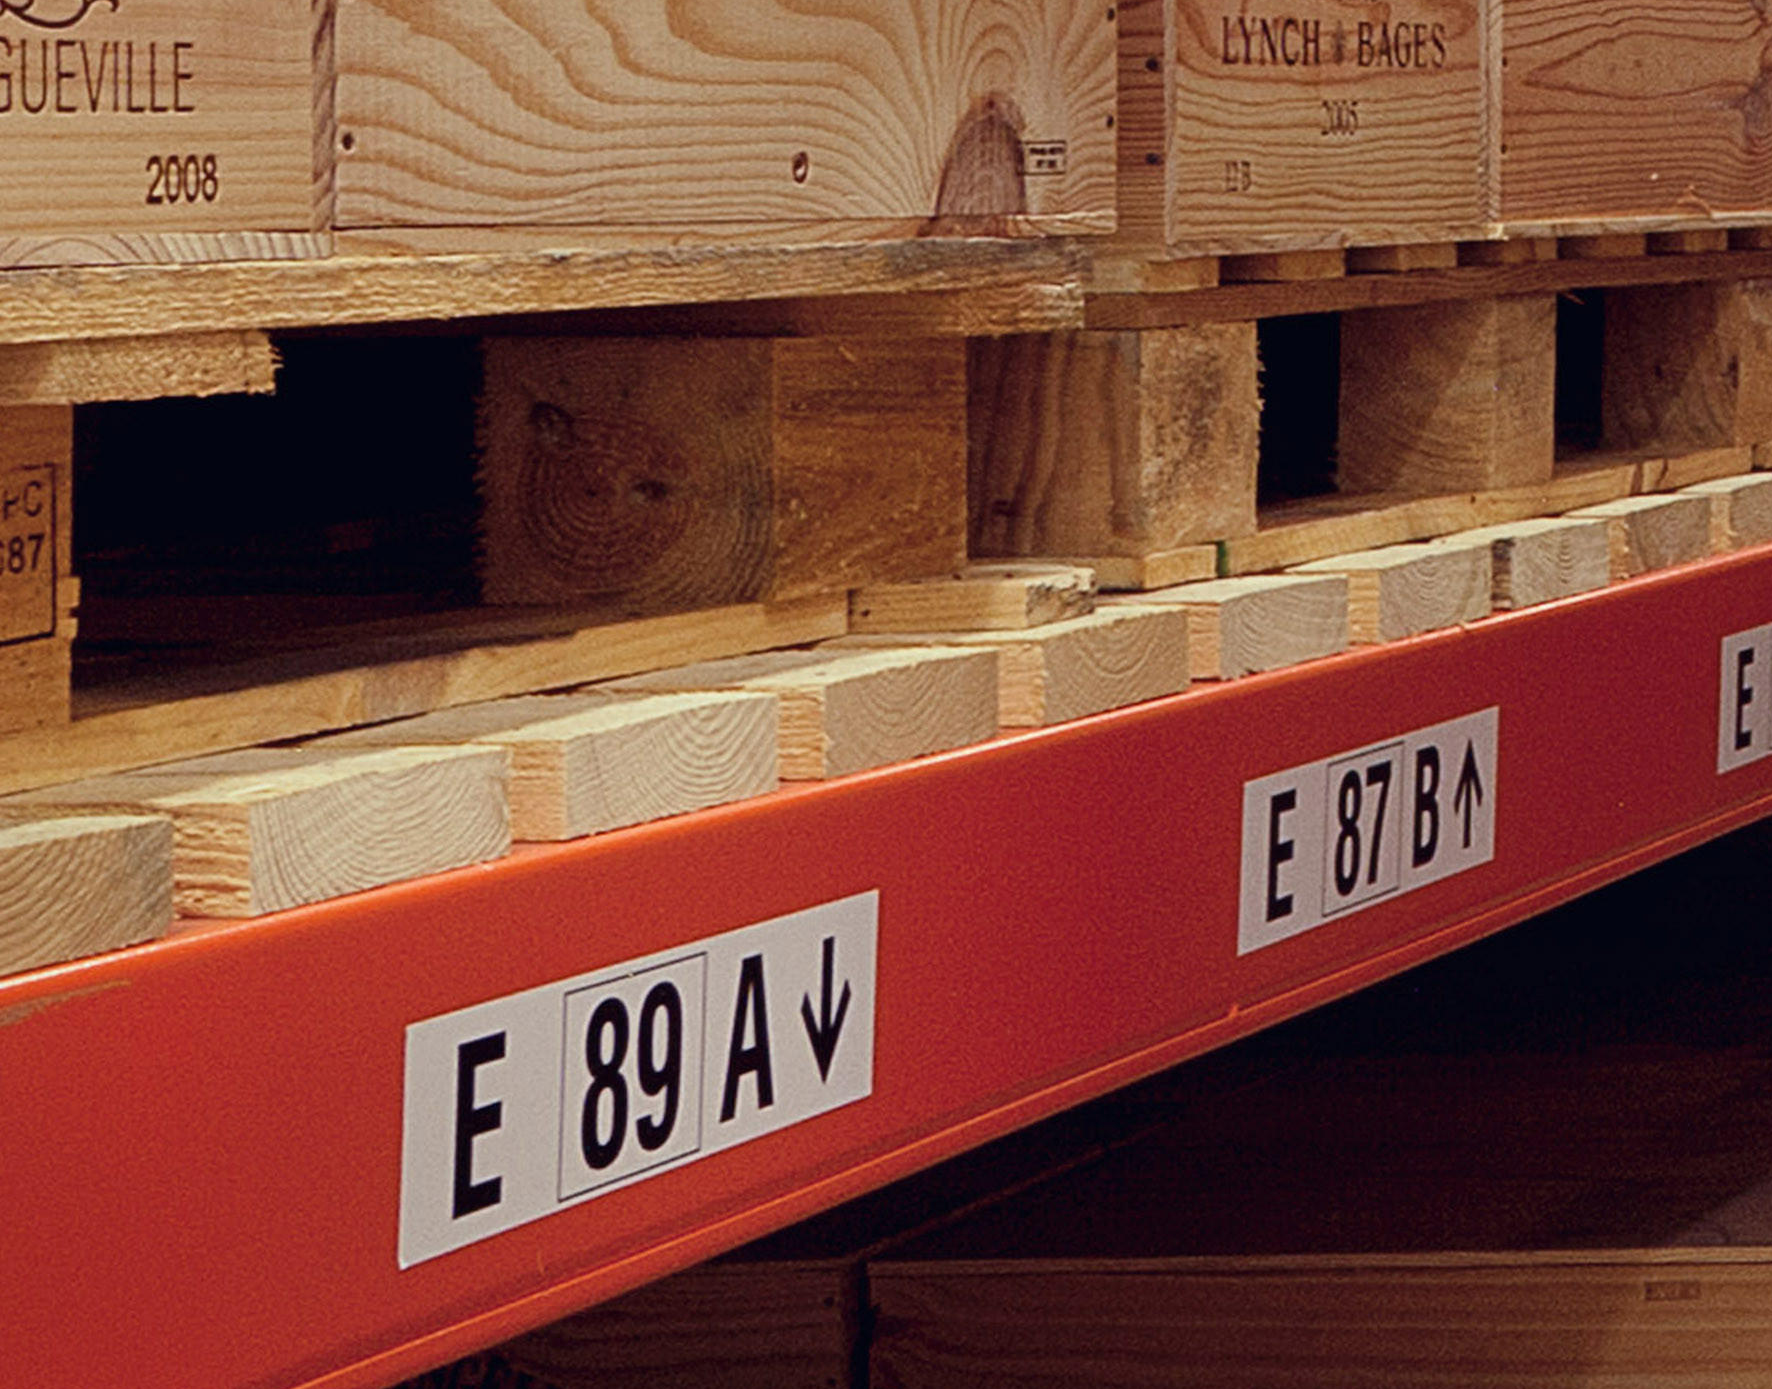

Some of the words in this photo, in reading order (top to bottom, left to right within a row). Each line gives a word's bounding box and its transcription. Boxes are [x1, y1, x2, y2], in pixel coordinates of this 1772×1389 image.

[1221, 16, 1320, 69] LYNCH
[1356, 20, 1447, 71] BAGES
[145, 154, 220, 205] 2008
[1734, 646, 1756, 752] E
[1264, 787, 1298, 925] E
[1333, 759, 1393, 900] 87
[1411, 743, 1442, 871] B
[452, 1029, 507, 1222] E
[580, 979, 684, 1172] 89
[719, 951, 775, 1125] A
